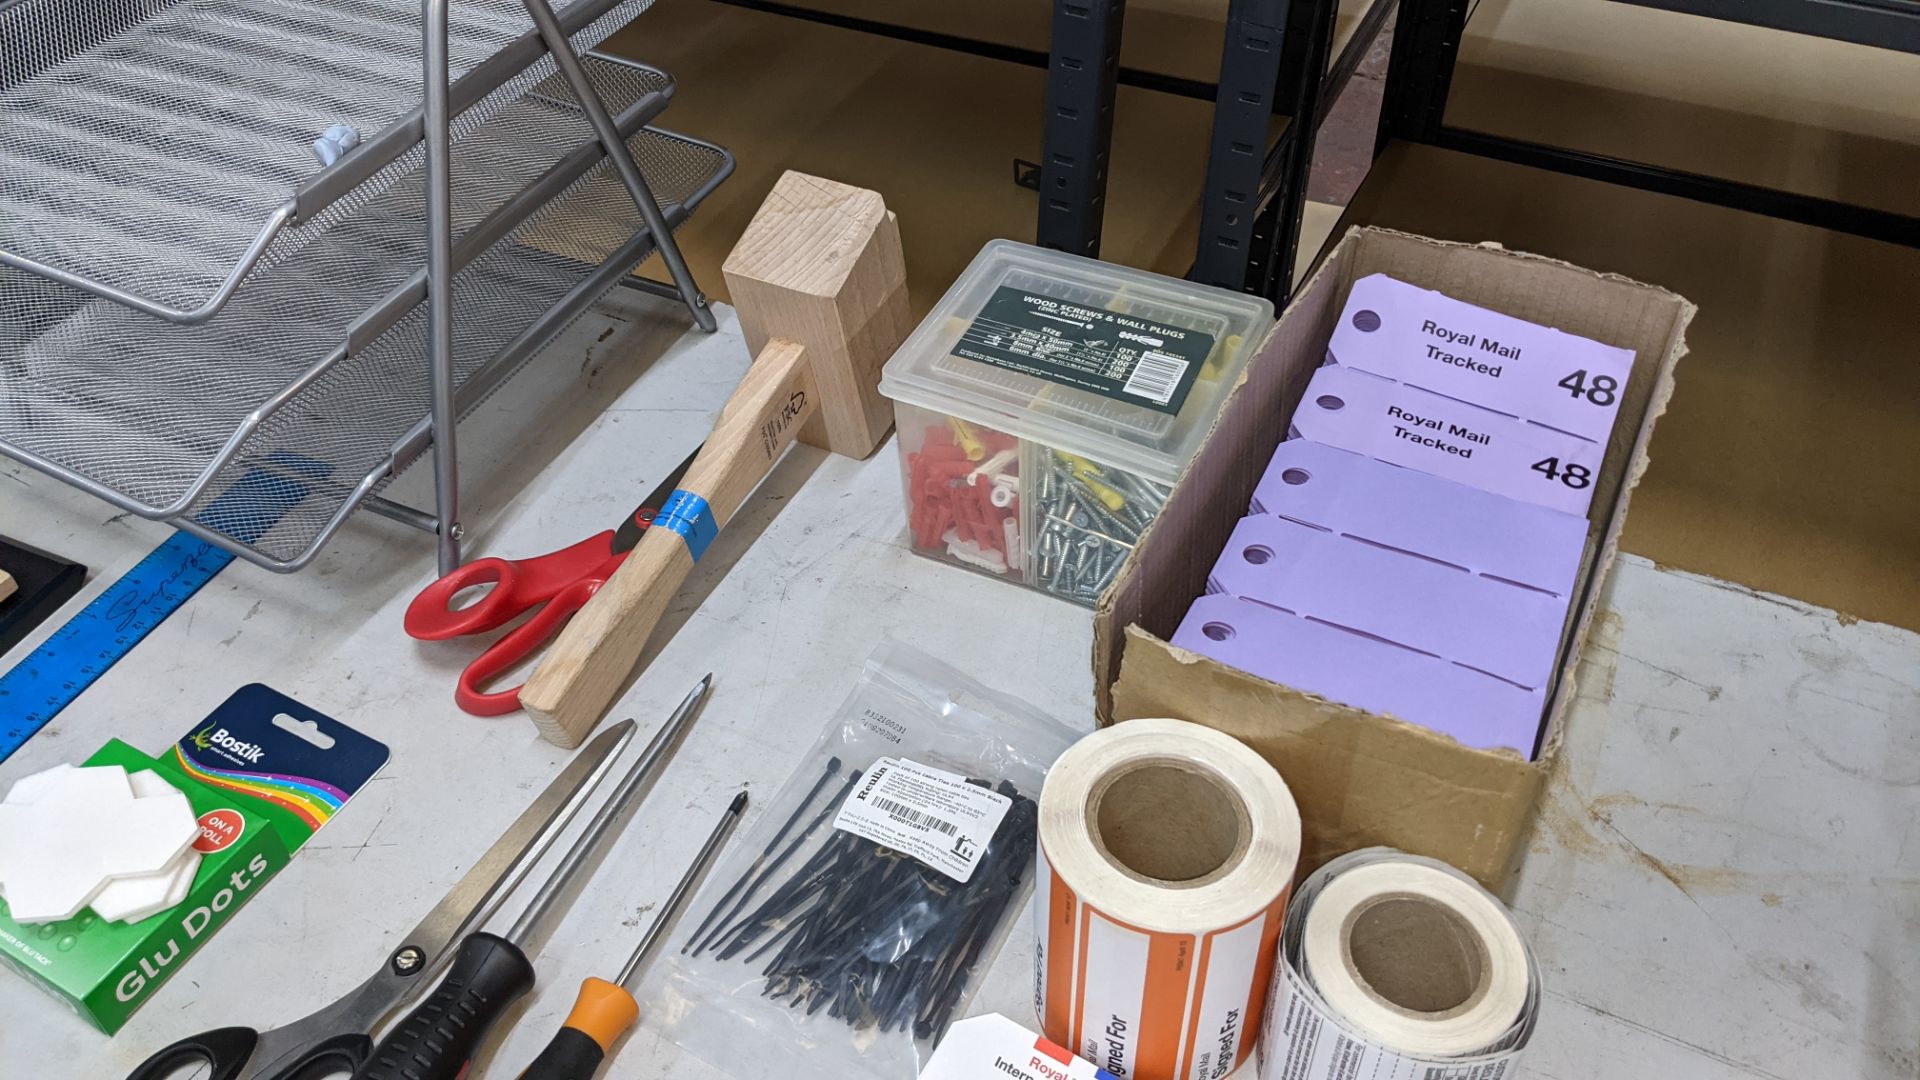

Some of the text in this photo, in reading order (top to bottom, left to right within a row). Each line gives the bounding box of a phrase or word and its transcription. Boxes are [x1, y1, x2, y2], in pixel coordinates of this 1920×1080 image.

[1023, 295, 1186, 340] WOOD SCREWS & WALL PLUGS
[1038, 306, 1092, 322] (ZINC PLATED)
[1041, 326, 1063, 337] SIZE
[1421, 319, 1521, 360] Royal Mail
[1032, 352, 1046, 360] dia.
[1104, 370, 1122, 379] 200
[1109, 364, 1126, 373] 100
[1112, 359, 1129, 368] 200
[1116, 353, 1132, 362] 100
[1118, 347, 1138, 356] QTY.
[1426, 344, 1502, 378] Tracked
[1558, 369, 1618, 407] 48
[1387, 406, 1491, 445] Royal Mail
[1393, 426, 1472, 459] Tracked
[1531, 456, 1592, 490] 48
[210, 728, 265, 764] Bostik
[857, 767, 889, 801] Reulin
[209, 817, 234, 835] ON A
[115, 852, 268, 1003] Glu Dots
[1105, 1014, 1127, 1077] igned For
[1211, 1008, 1240, 1080] Signed For
